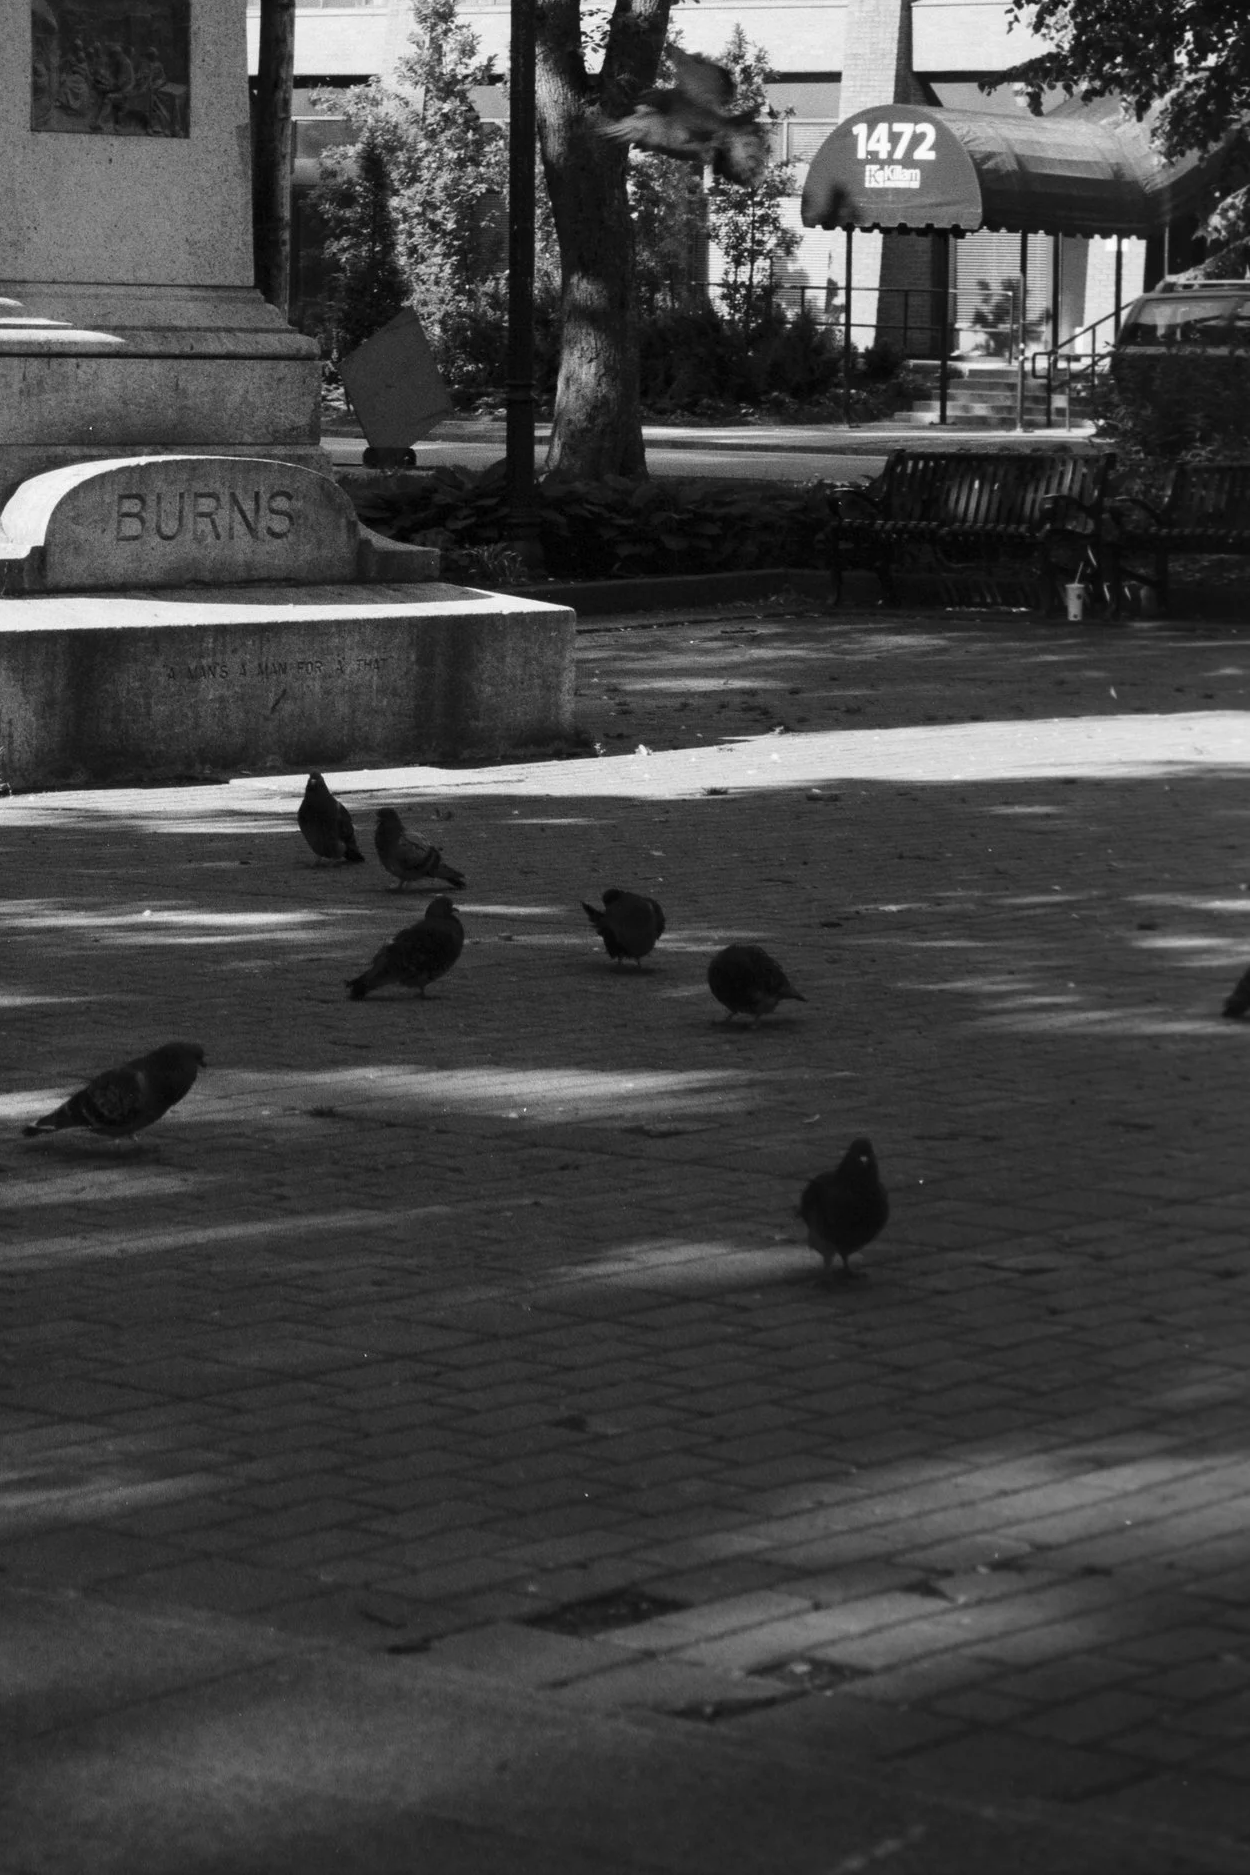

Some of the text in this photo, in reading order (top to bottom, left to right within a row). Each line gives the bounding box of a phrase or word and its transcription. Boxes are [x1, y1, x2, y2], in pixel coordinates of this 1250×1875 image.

[851, 122, 936, 161] 1472
[884, 164, 921, 182] Killam
[116, 489, 295, 541] BURNS
[257, 660, 289, 678] MAN
[297, 660, 324, 675] FOR
